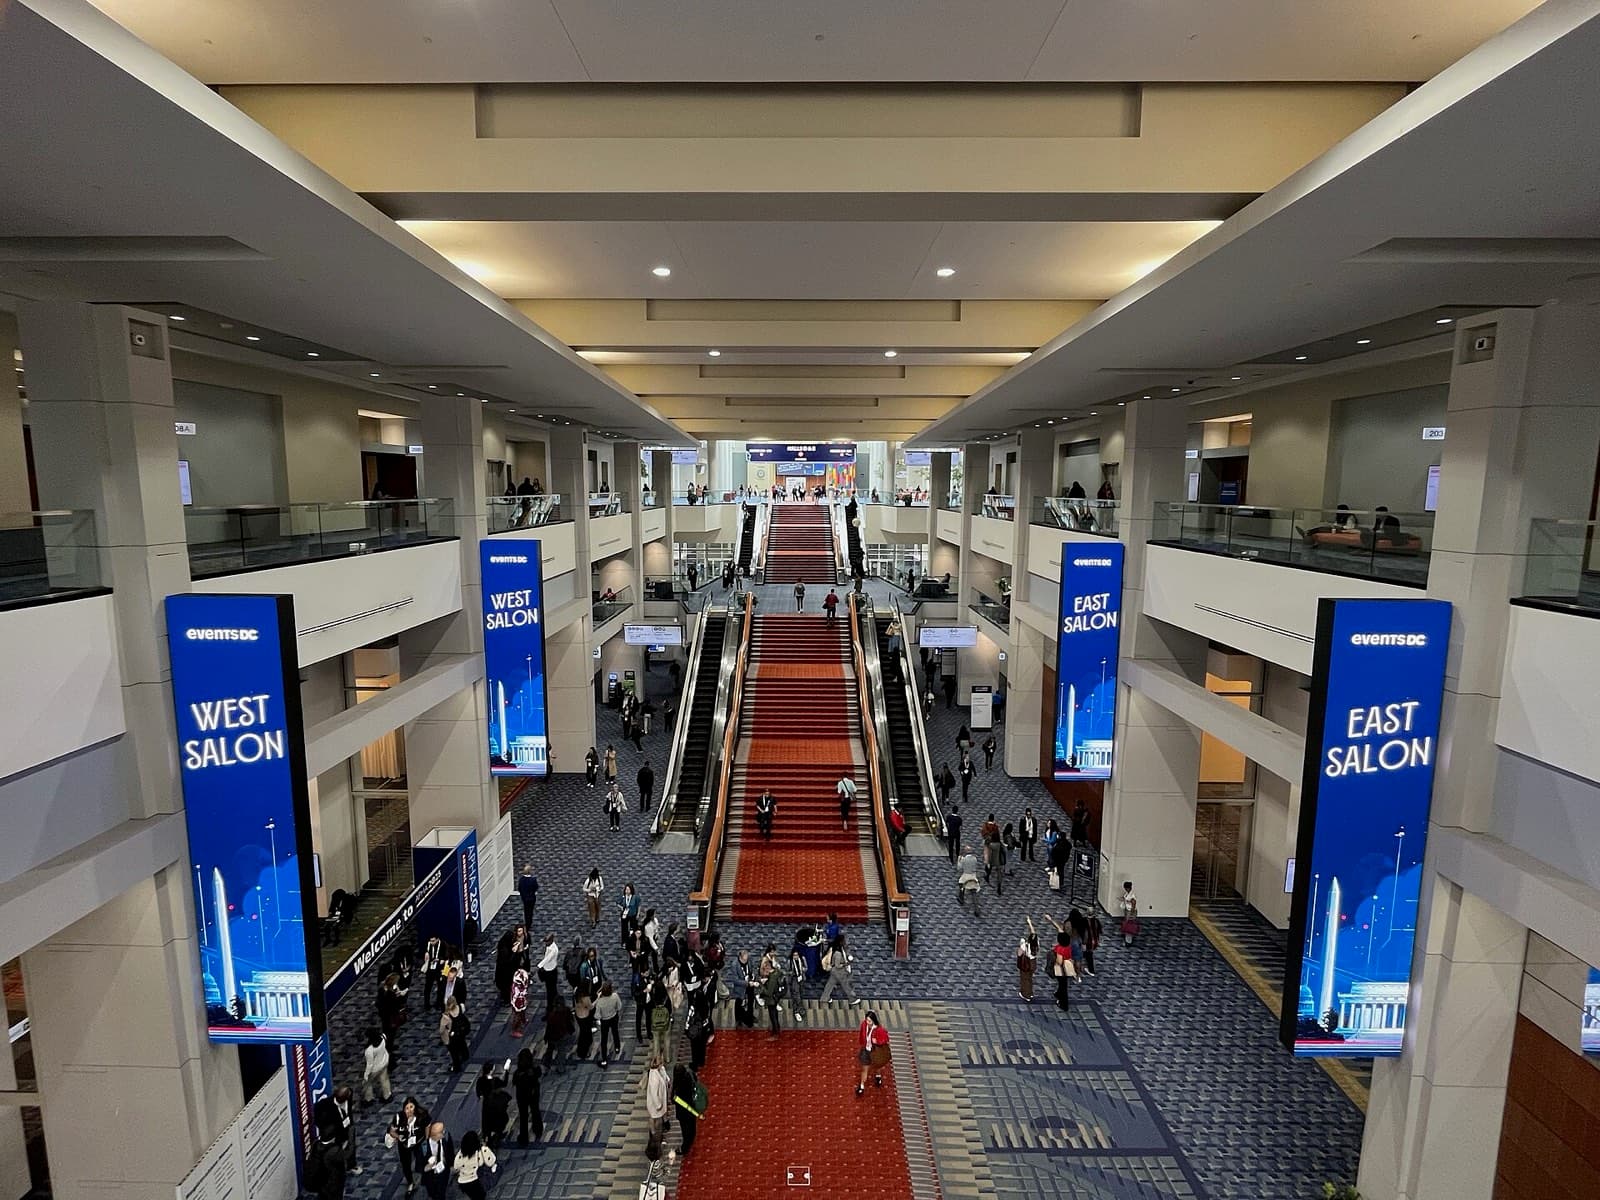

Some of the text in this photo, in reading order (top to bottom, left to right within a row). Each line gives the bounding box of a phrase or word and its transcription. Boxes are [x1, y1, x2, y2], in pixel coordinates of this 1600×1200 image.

[490, 589, 533, 610] WEST
[1074, 593, 1111, 613] EAST
[486, 608, 538, 630] SALON
[1063, 611, 1118, 634] SALON
[190, 694, 270, 732] WEST
[1347, 701, 1420, 739] EAST
[185, 730, 285, 770] SALON
[1325, 736, 1431, 778] SALON
[353, 918, 402, 976] Welcome
[402, 905, 414, 921] to
